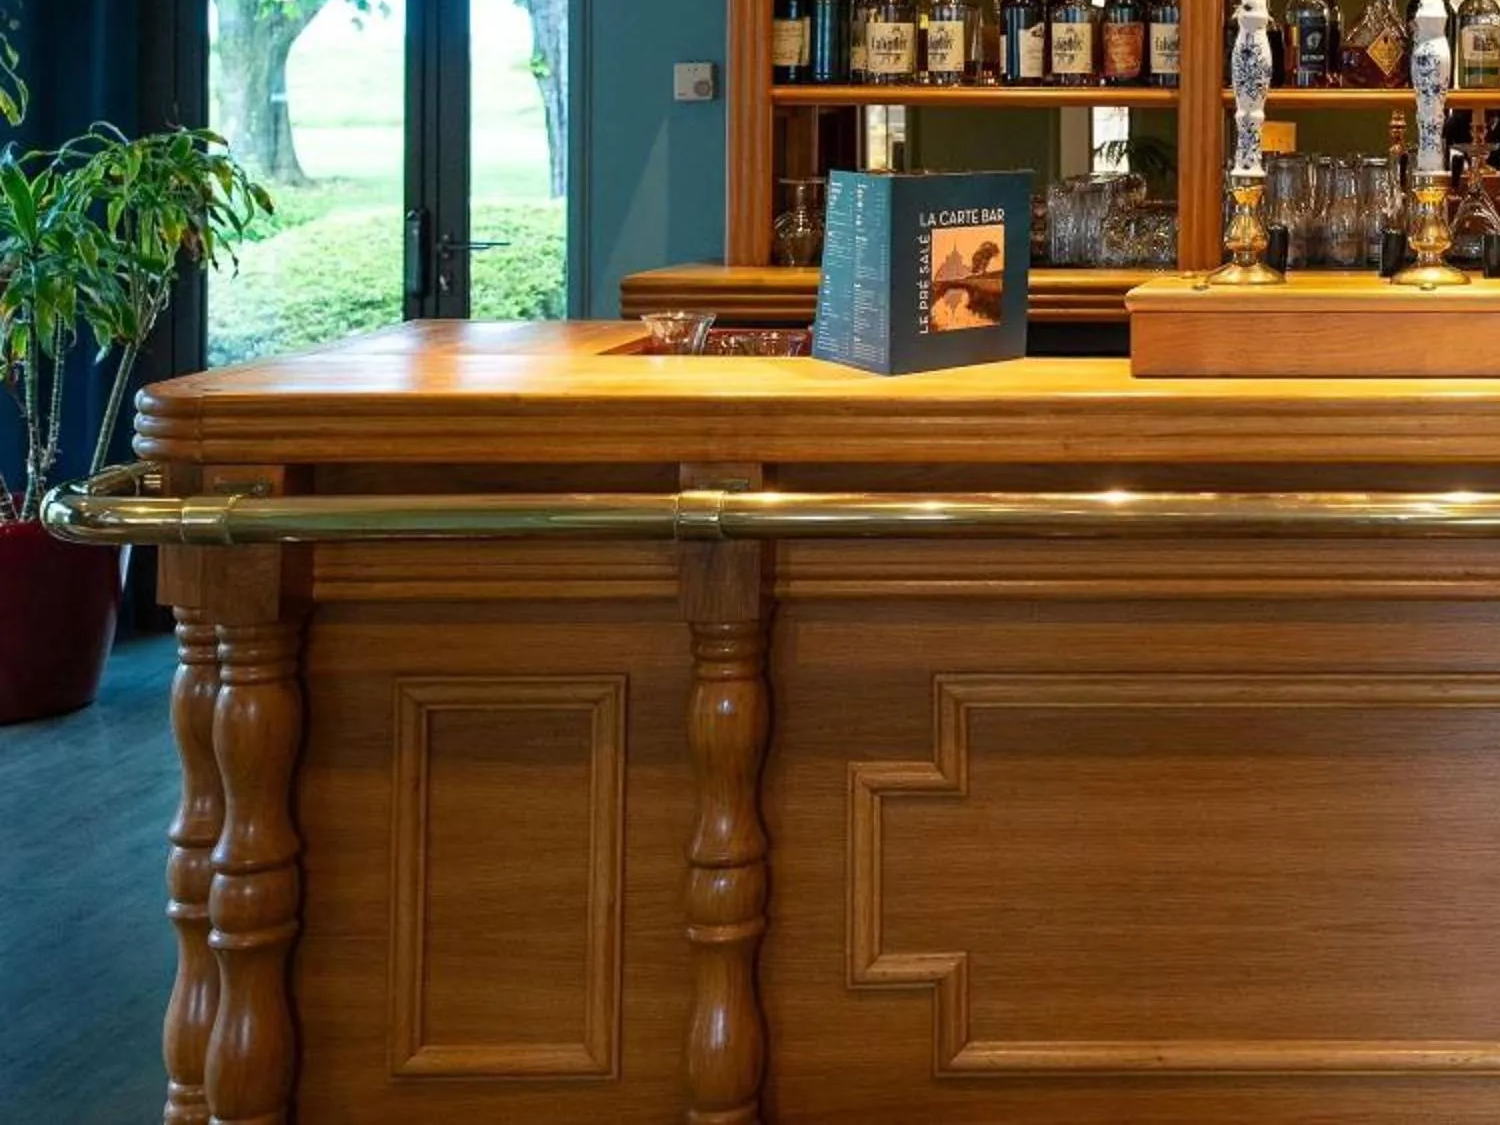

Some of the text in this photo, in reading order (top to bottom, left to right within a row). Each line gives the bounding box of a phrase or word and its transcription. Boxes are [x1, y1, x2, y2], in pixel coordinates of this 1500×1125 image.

[919, 208, 1005, 227] LA CARTE BAR
[917, 233, 931, 335] LE PRÉ SALÉ
